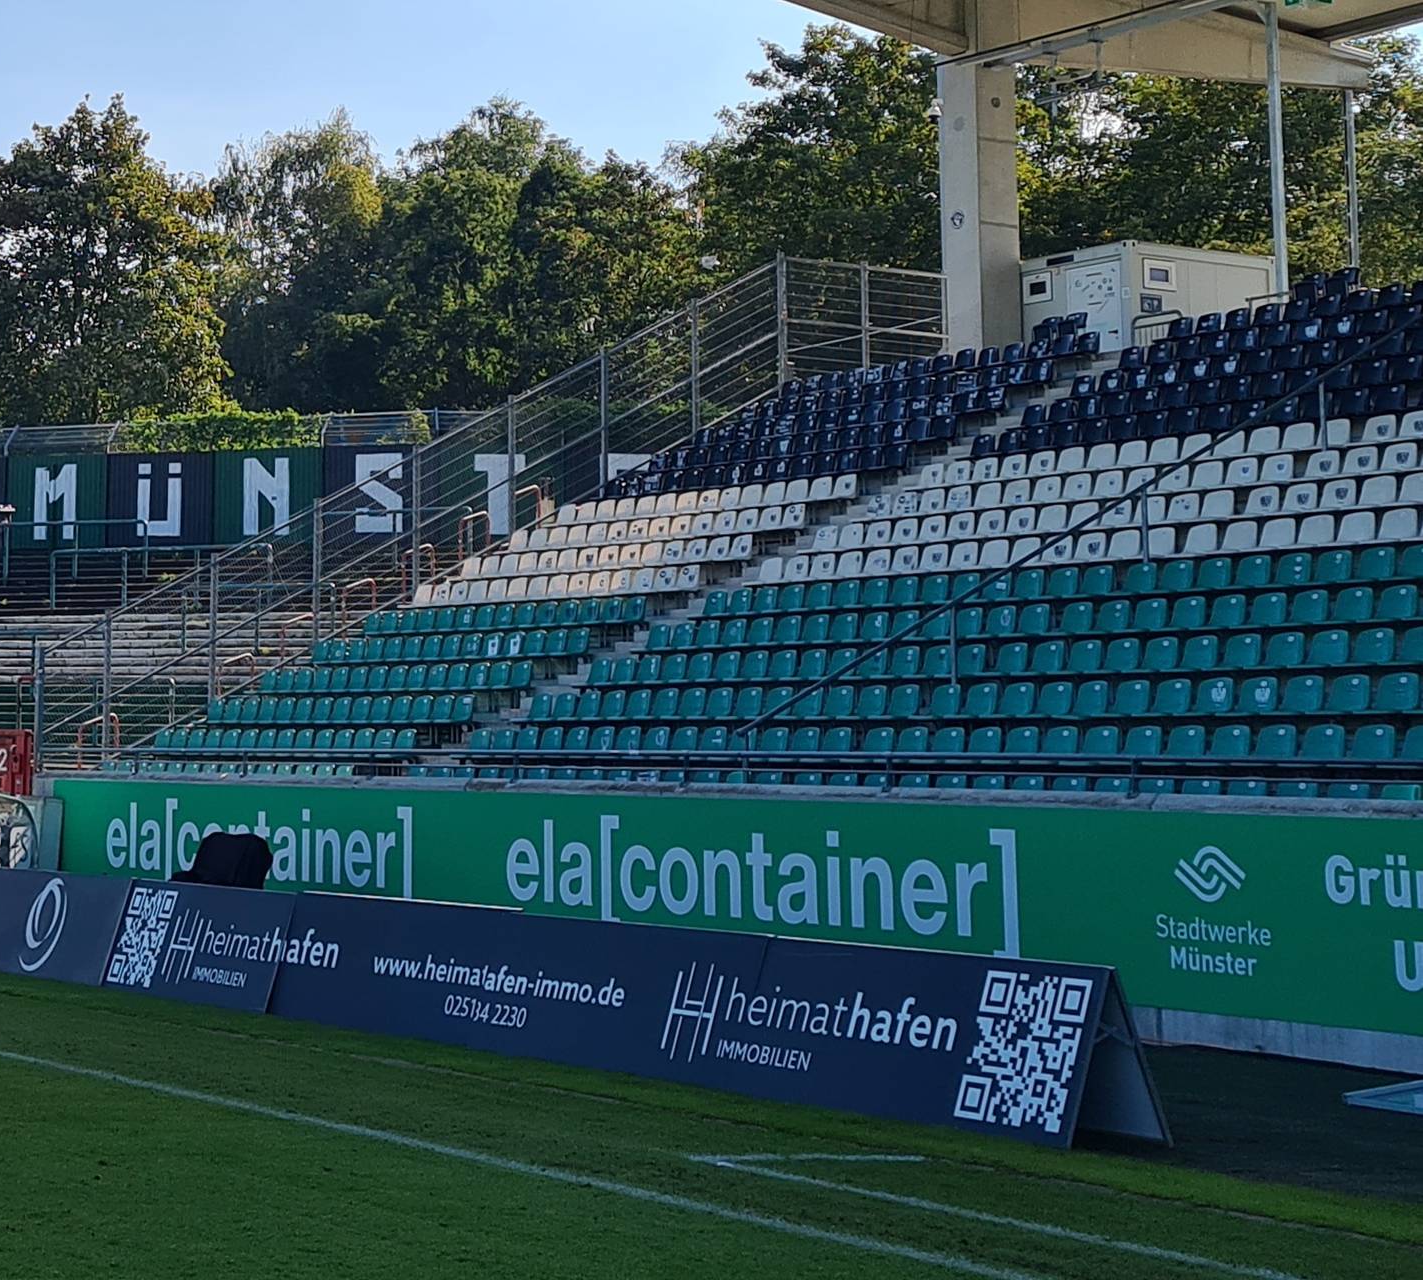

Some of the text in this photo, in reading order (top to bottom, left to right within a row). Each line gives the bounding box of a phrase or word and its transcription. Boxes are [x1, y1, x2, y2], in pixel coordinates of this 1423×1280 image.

[1156, 913, 1271, 947] Stadtwerke
[1170, 945, 1257, 977] Münster
[192, 967, 247, 988] IMMOBILIEN
[491, 1004, 527, 1028] 2230
[725, 977, 958, 1051] heimathafen
[716, 1039, 812, 1072] IMMOBILIEN
